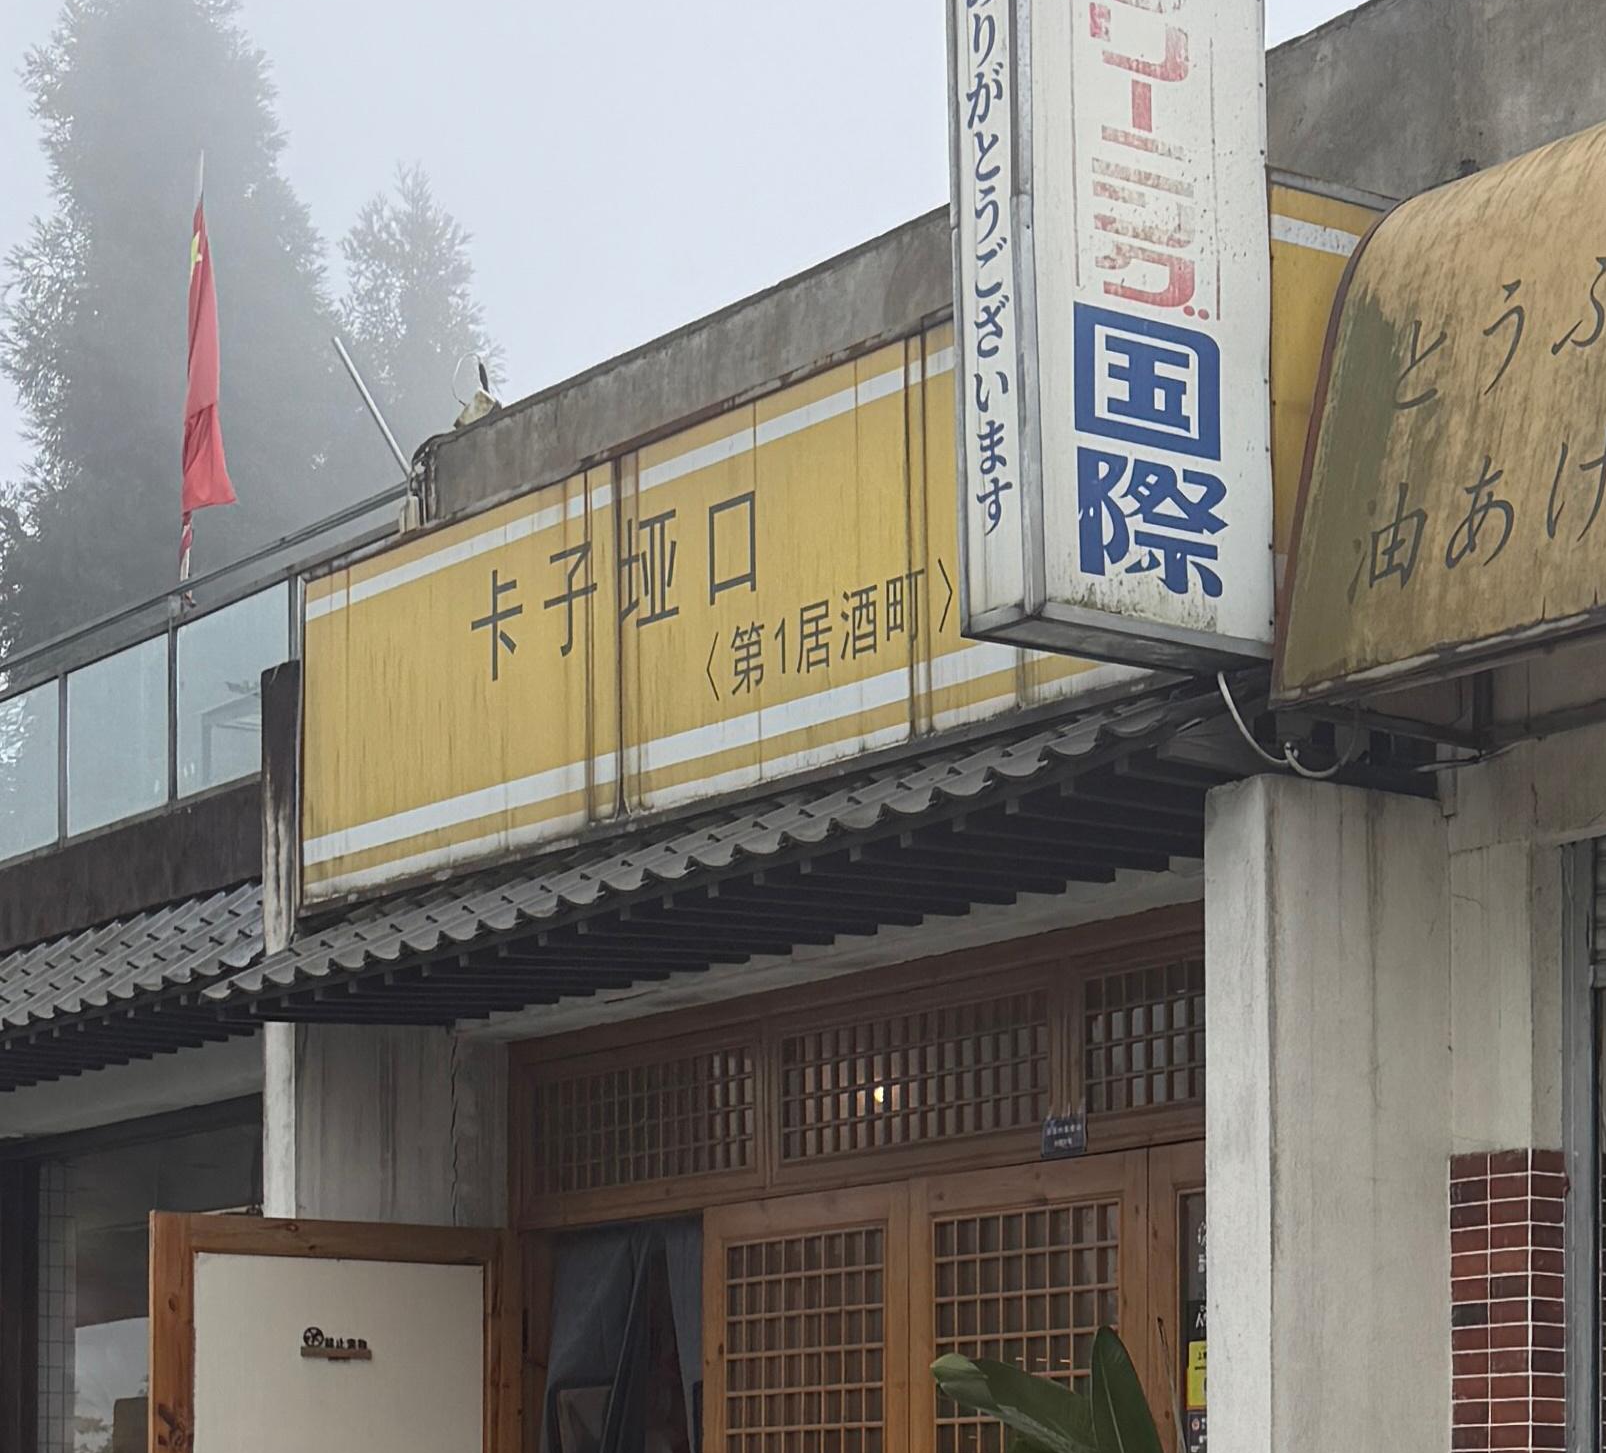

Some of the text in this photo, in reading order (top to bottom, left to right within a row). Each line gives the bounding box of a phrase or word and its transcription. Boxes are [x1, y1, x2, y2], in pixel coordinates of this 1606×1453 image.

[1073, 302, 1230, 598] 国際
[470, 490, 758, 682] 卡子垭口
